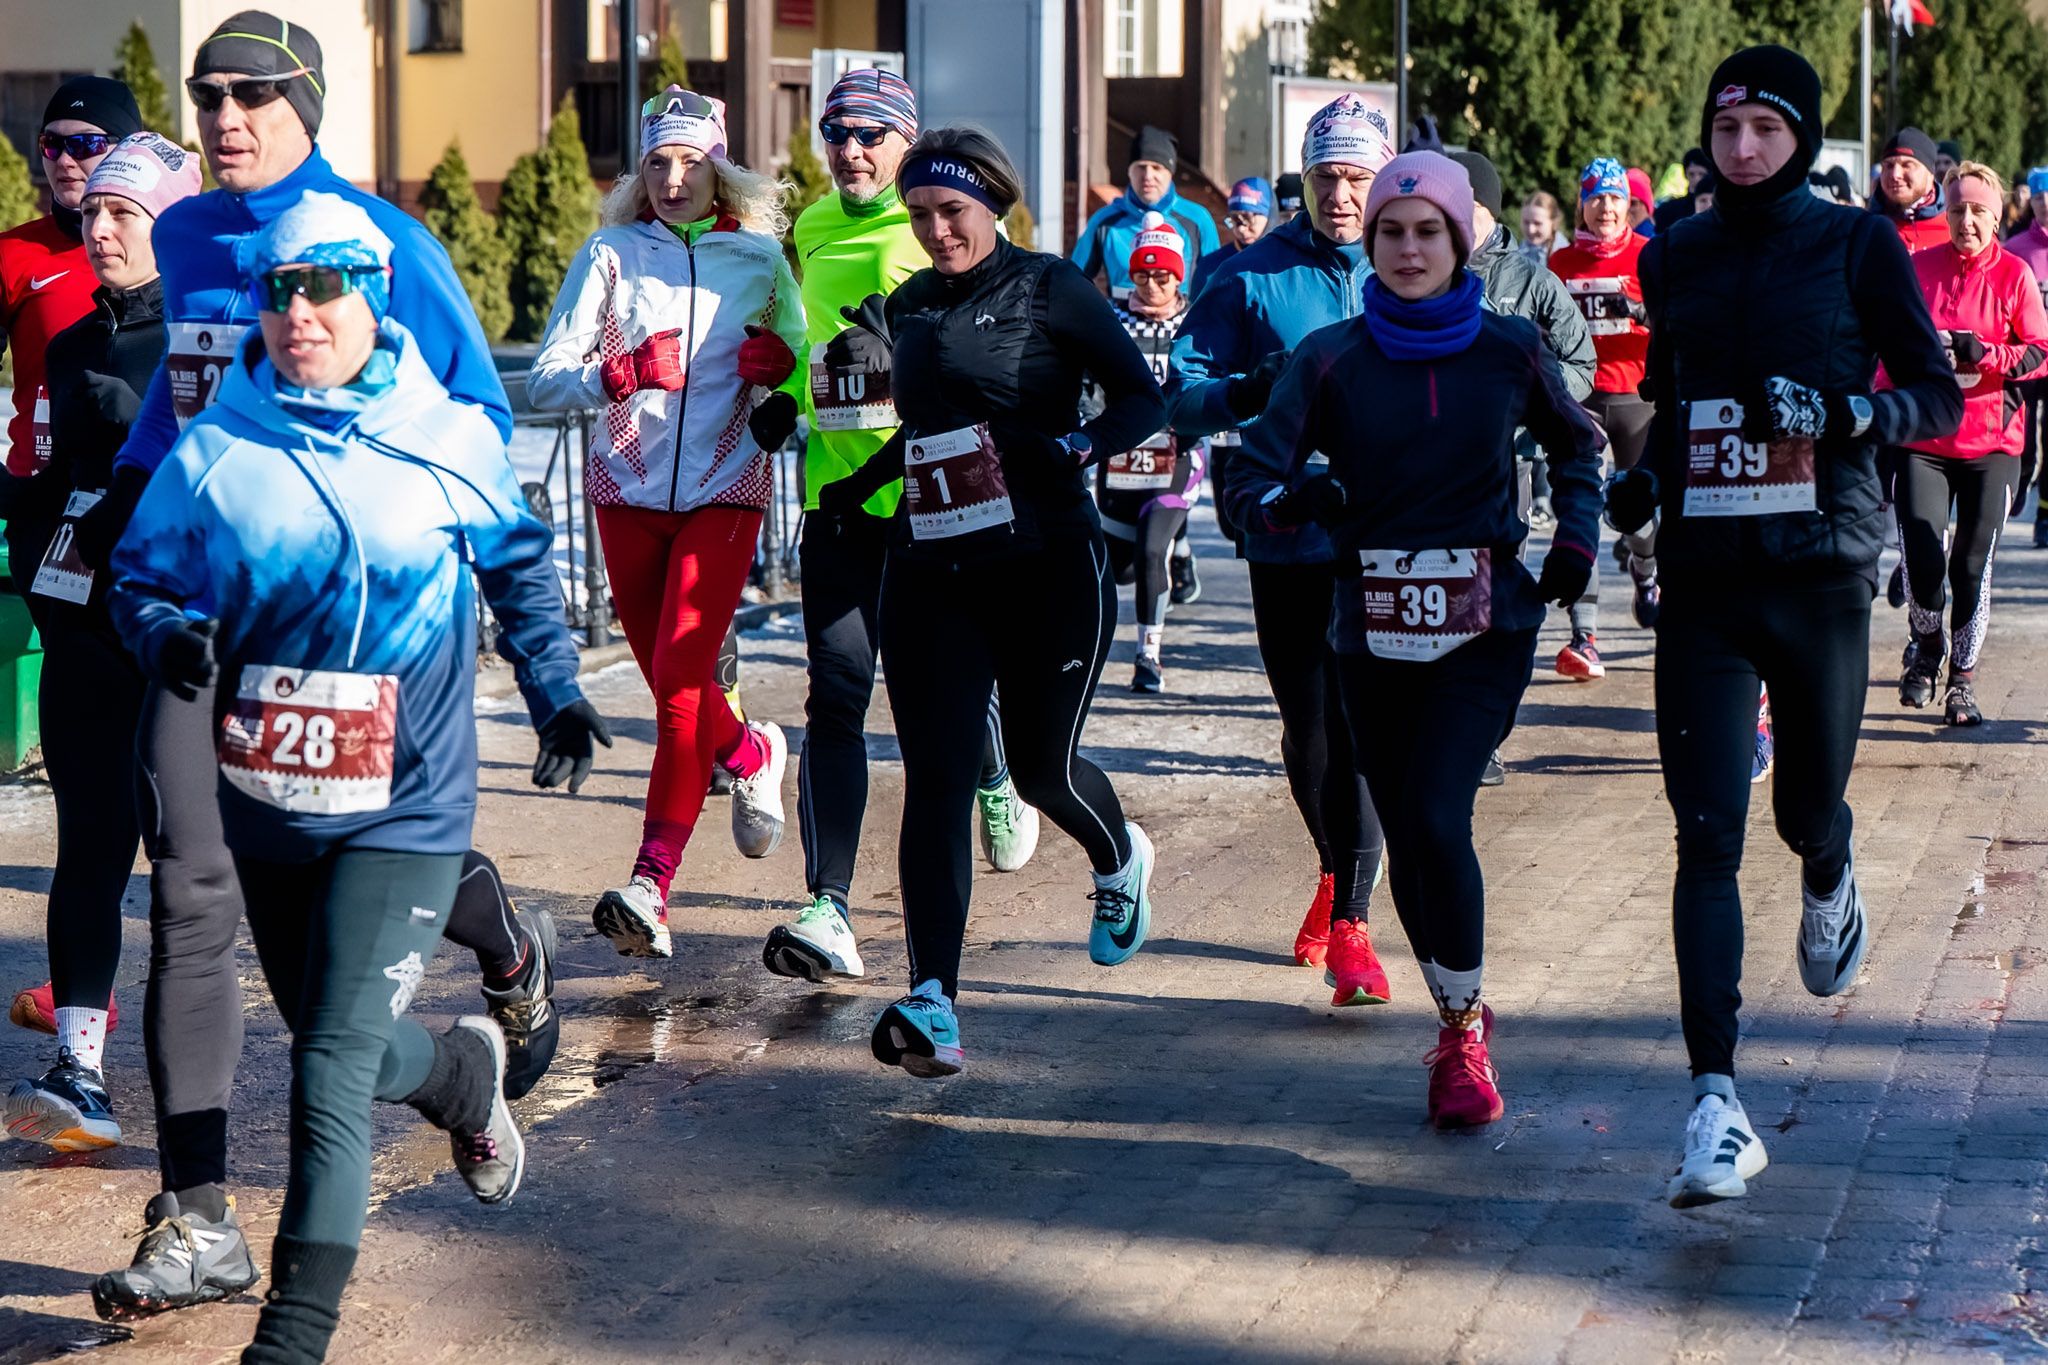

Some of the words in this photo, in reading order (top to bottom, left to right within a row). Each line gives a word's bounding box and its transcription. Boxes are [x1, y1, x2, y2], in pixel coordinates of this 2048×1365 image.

[1130, 450, 1156, 473] 25
[1720, 434, 1768, 479] 39
[932, 467, 952, 504] 1
[1365, 591, 1395, 602] 11.BIEG
[1400, 584, 1447, 627] 39
[272, 711, 336, 769] 28
